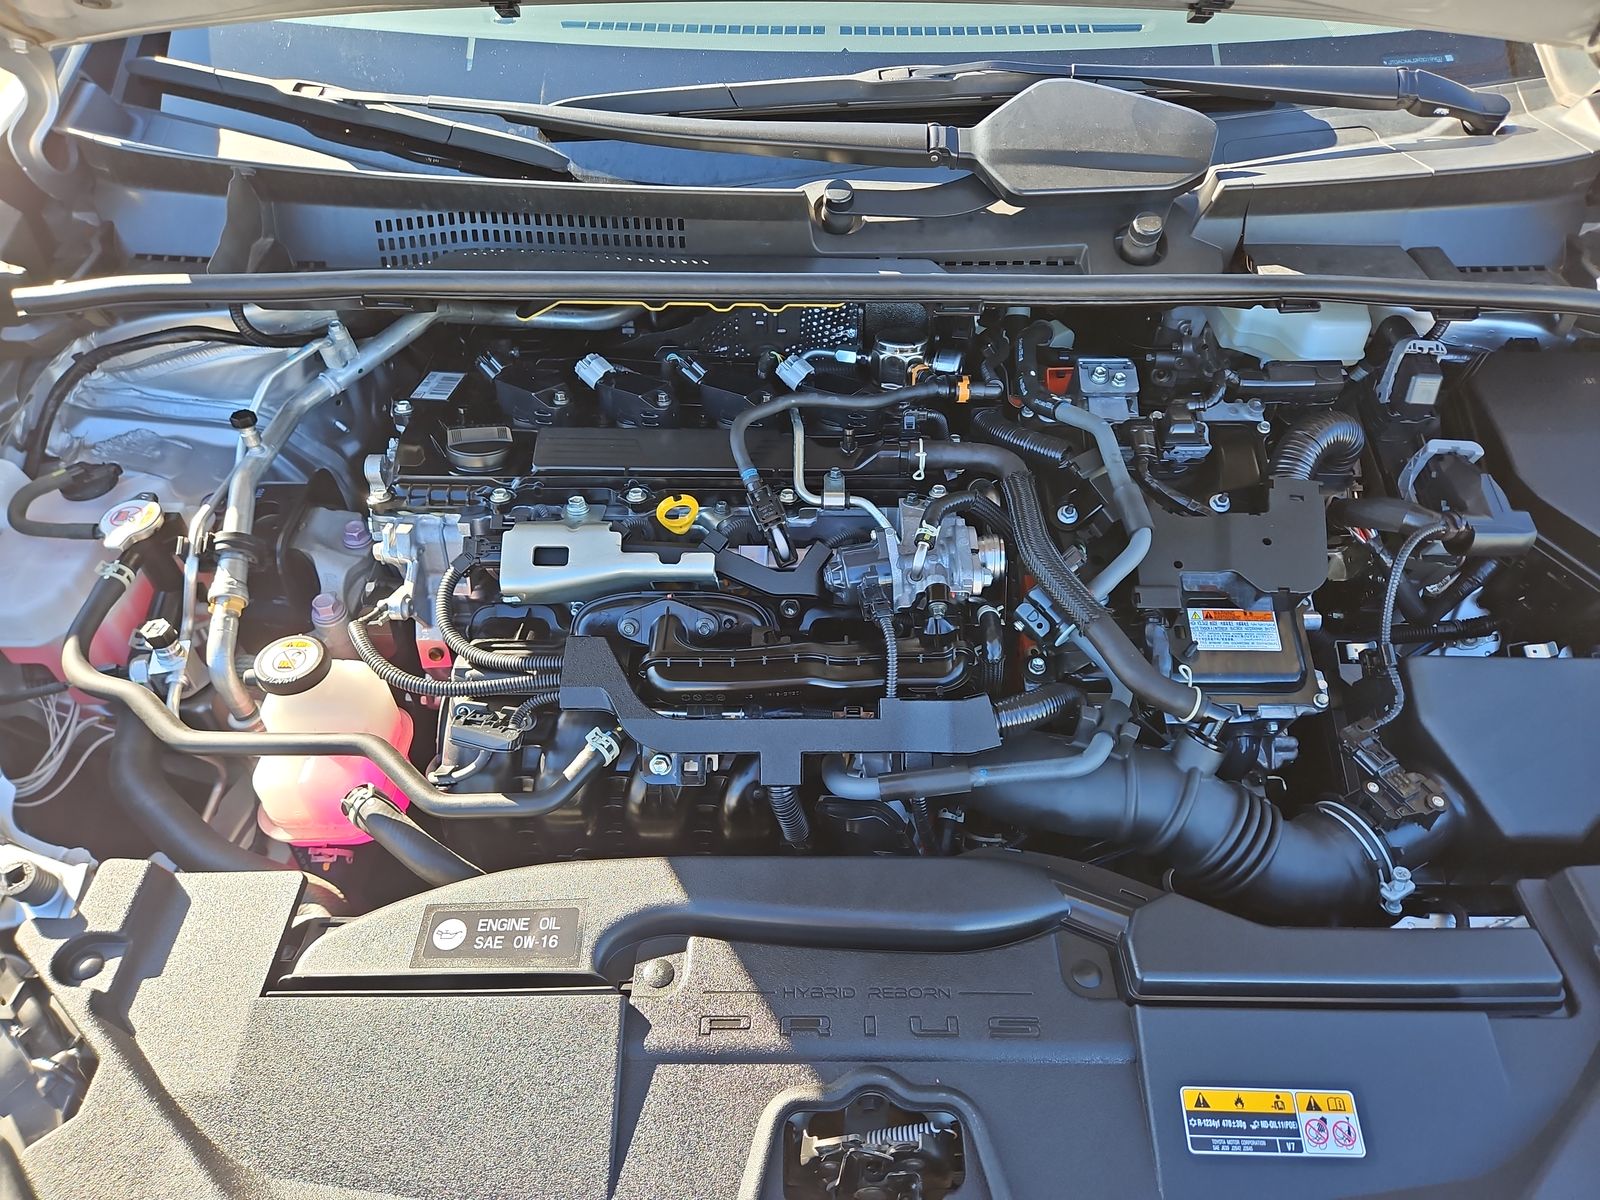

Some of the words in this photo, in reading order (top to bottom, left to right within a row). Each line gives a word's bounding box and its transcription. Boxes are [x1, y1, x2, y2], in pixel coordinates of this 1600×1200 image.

[477, 917, 531, 932] ENGINE
[539, 917, 561, 930] OIL
[473, 936, 504, 949] SAE
[513, 935, 559, 949] 0W-16
[782, 986, 856, 1000] HYBRID
[867, 986, 951, 999] REBORN
[700, 1014, 1041, 1039] PRIUS
[1286, 1141, 1296, 1152] V7
